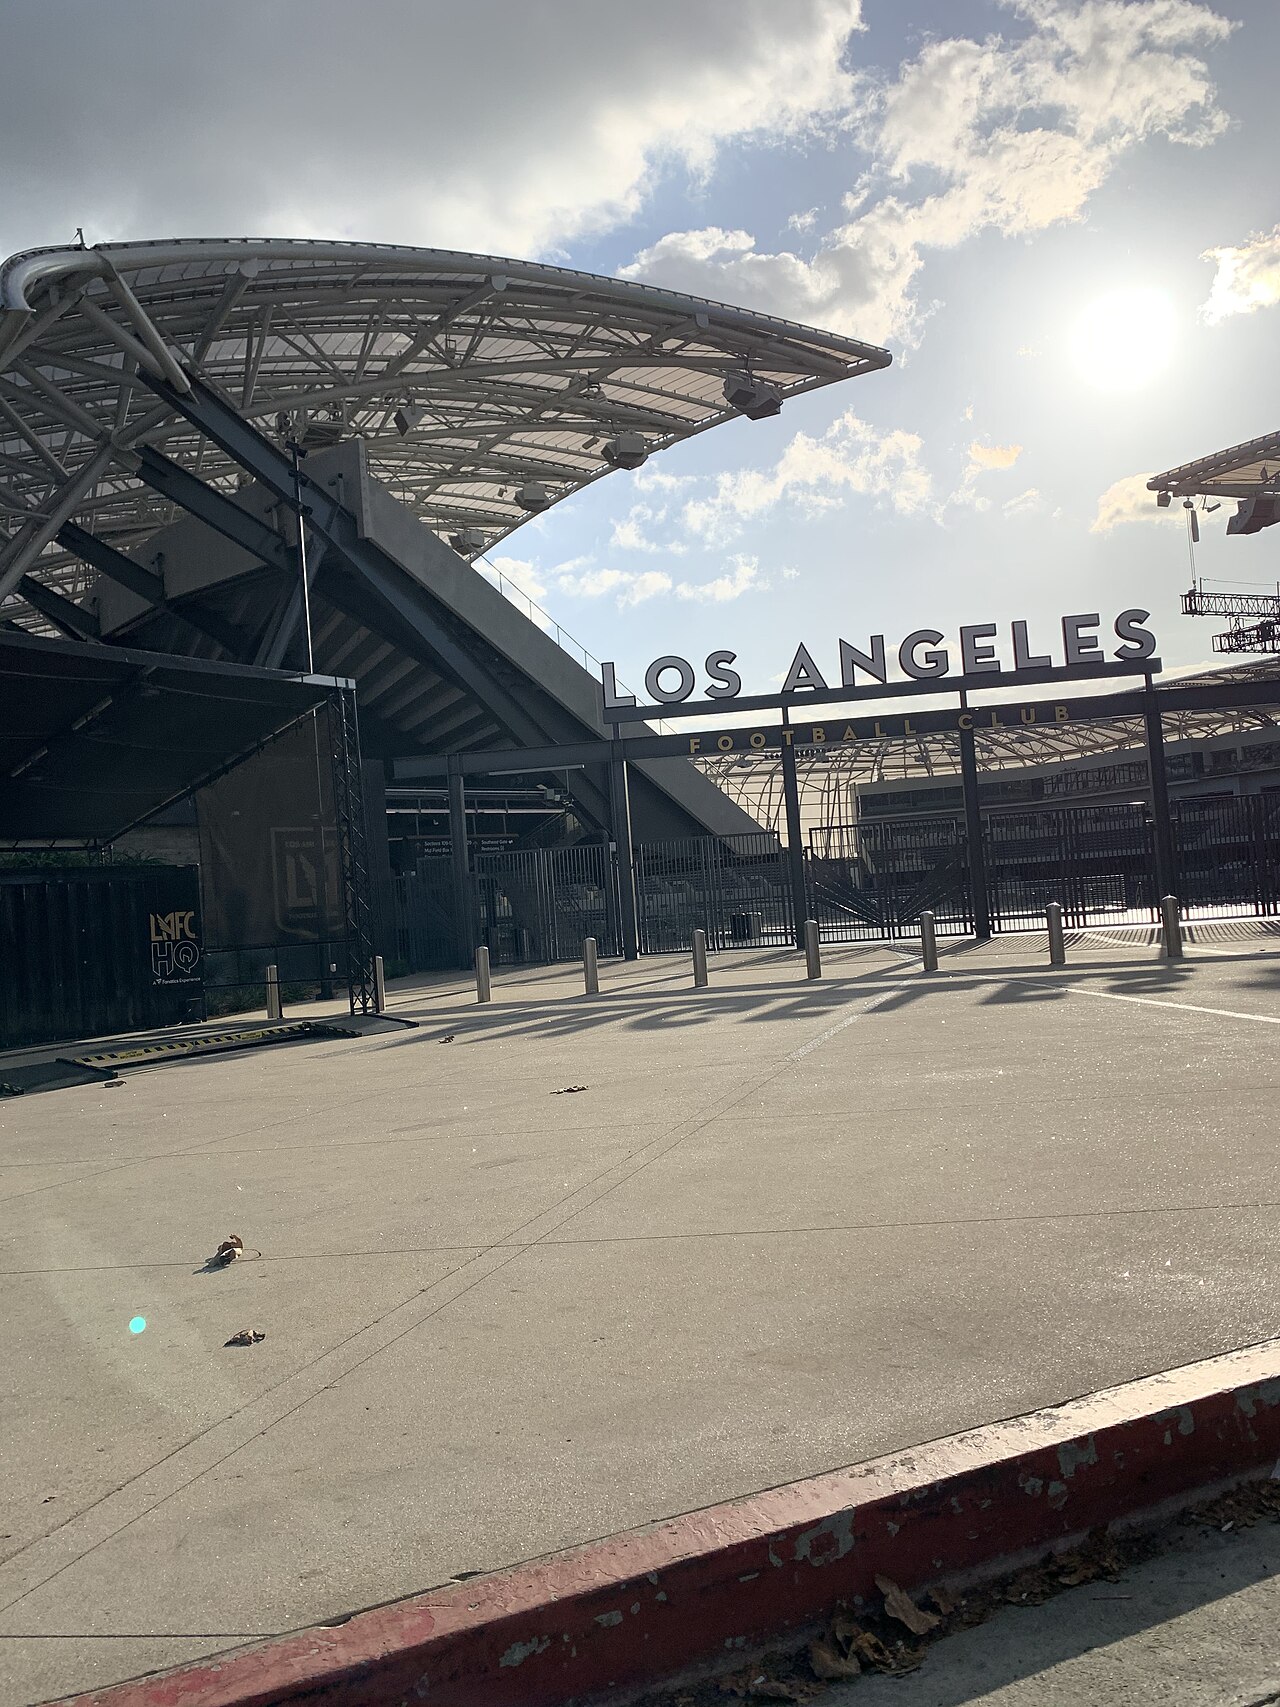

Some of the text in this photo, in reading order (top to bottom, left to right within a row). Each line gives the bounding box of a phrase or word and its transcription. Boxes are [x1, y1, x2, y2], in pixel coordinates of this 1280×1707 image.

[601, 608, 1157, 708] LOS ANGELES
[690, 705, 1070, 754] FOOTBALL CLUB
[149, 911, 196, 942] LAFC
[151, 940, 200, 977] HQ
